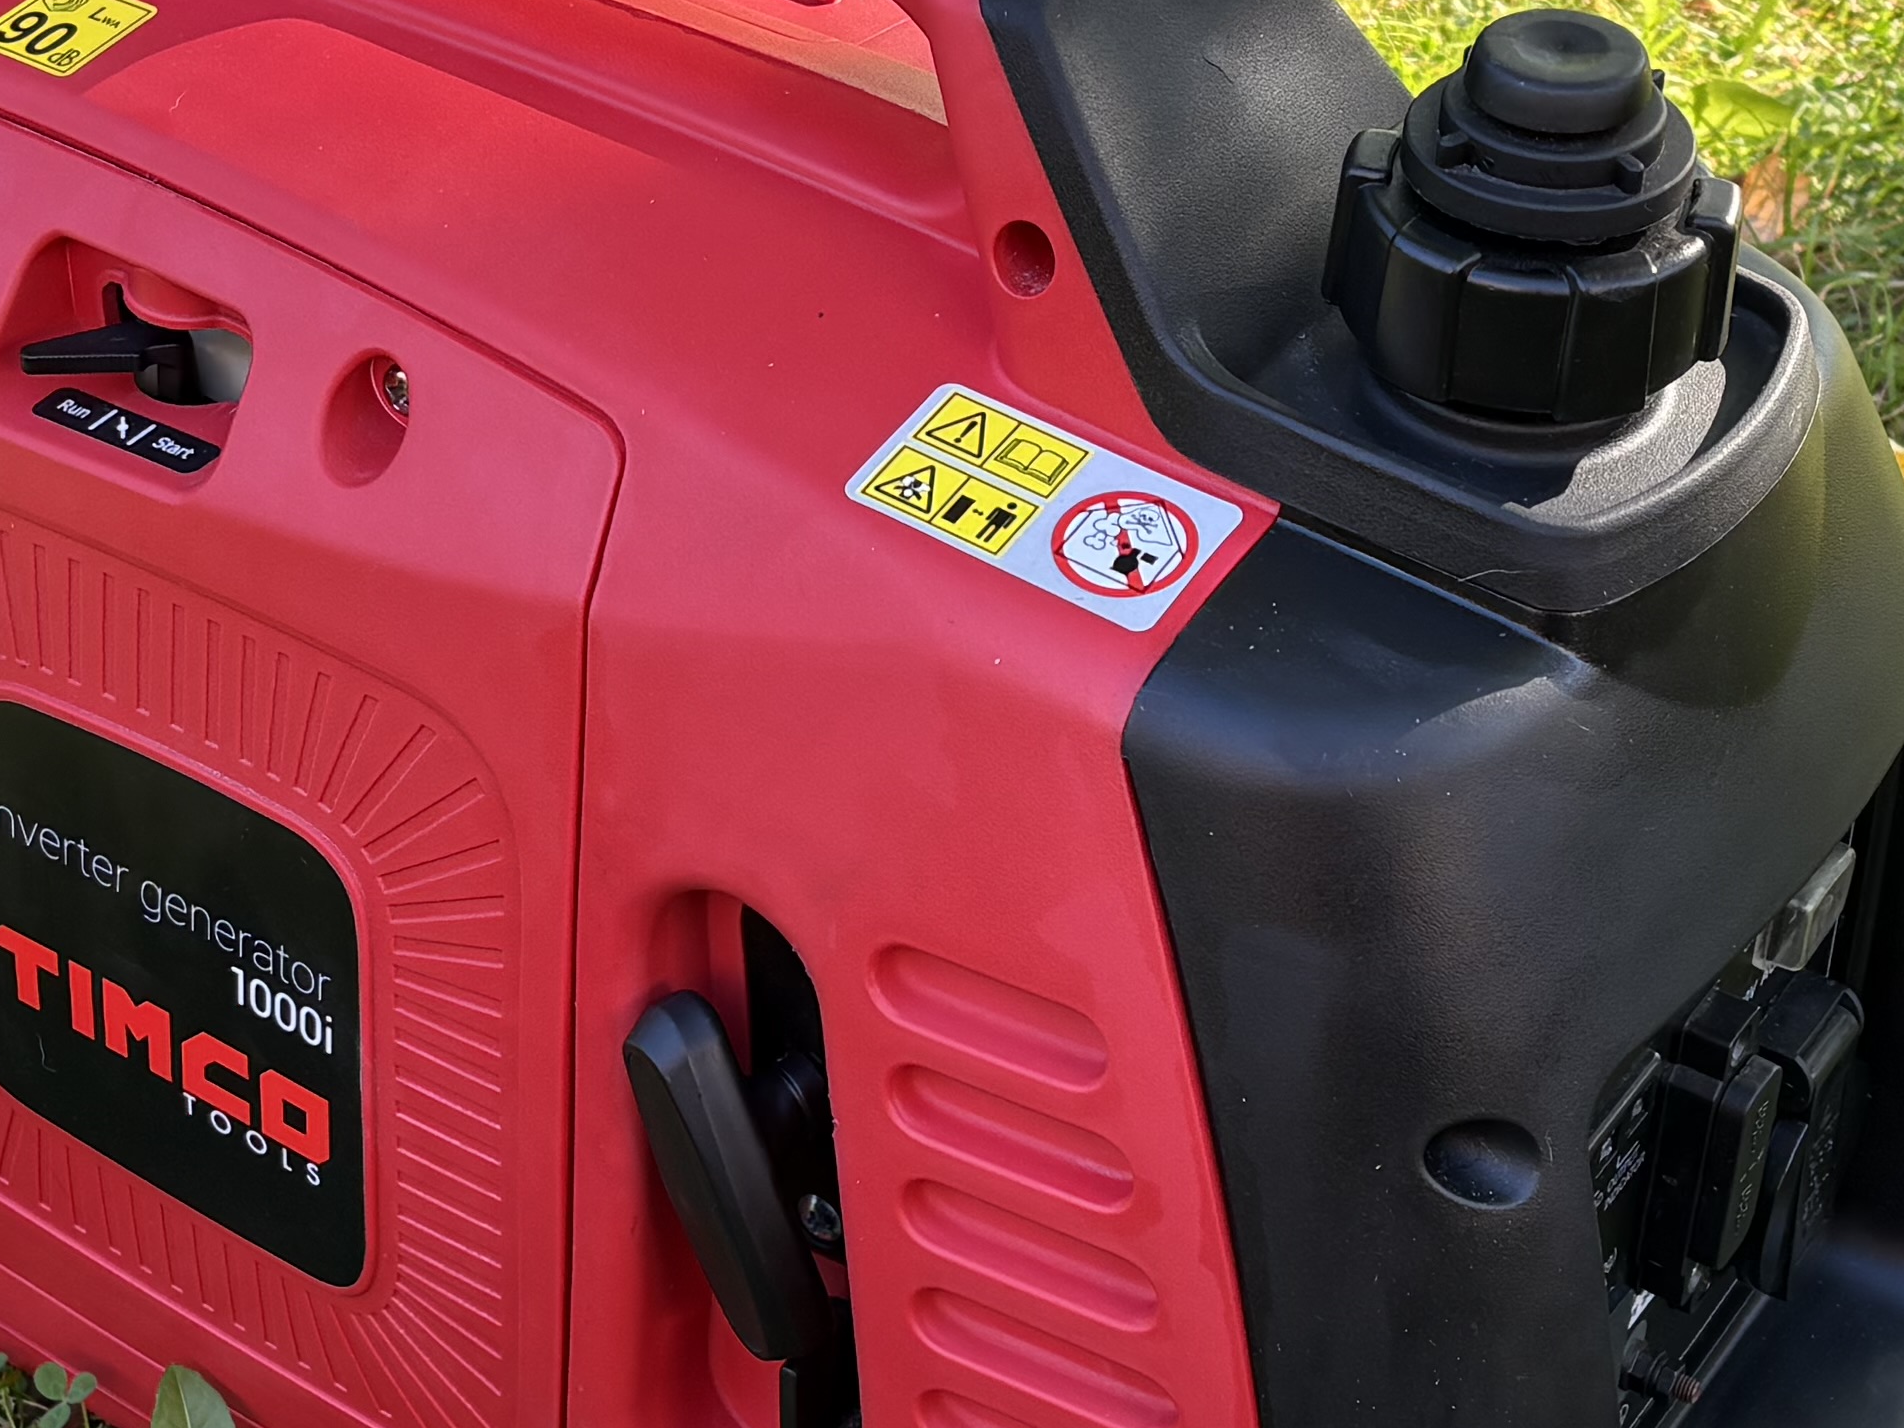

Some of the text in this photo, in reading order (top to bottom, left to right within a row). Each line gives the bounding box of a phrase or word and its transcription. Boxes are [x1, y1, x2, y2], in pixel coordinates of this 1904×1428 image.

[48, 48, 80, 68] dB
[56, 397, 195, 460] Run Start
[140, 879, 332, 1002] generator
[231, 966, 333, 1055] 1000i
[183, 1092, 320, 1187] TOOLS
